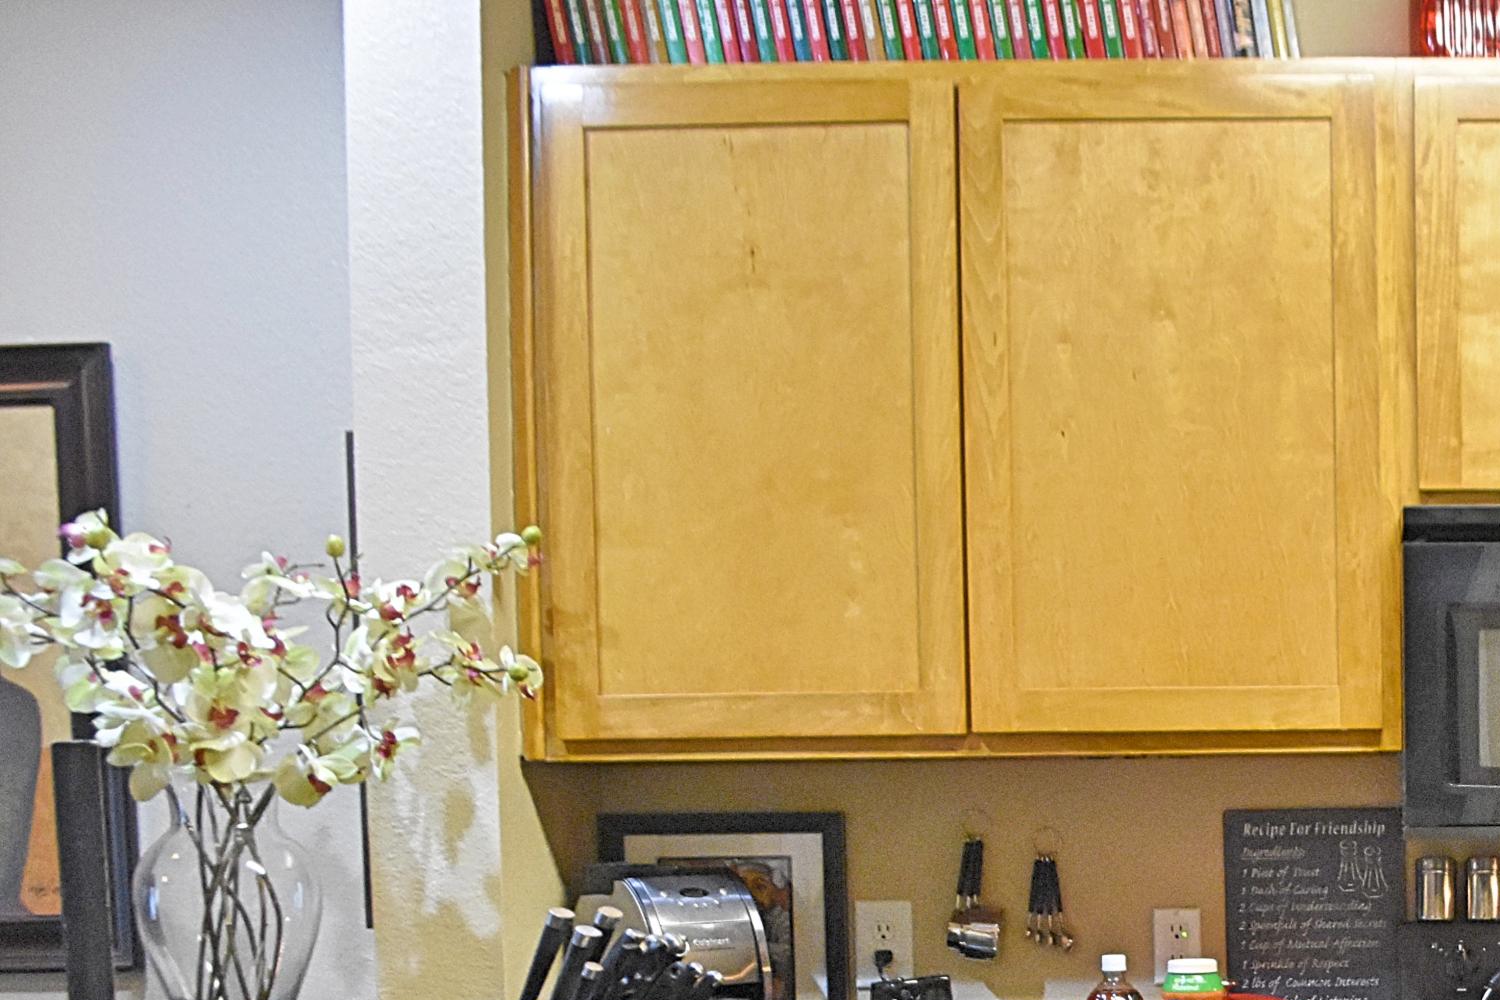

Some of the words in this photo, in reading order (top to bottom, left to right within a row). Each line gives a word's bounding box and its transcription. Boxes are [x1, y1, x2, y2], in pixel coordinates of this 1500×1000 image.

[1243, 822, 1286, 839] Recipe
[1289, 822, 1311, 836] For
[1314, 820, 1386, 838] Friendship
[1242, 978, 1249, 989] 2
[1252, 976, 1265, 989] lbs
[1267, 975, 1282, 995] of
